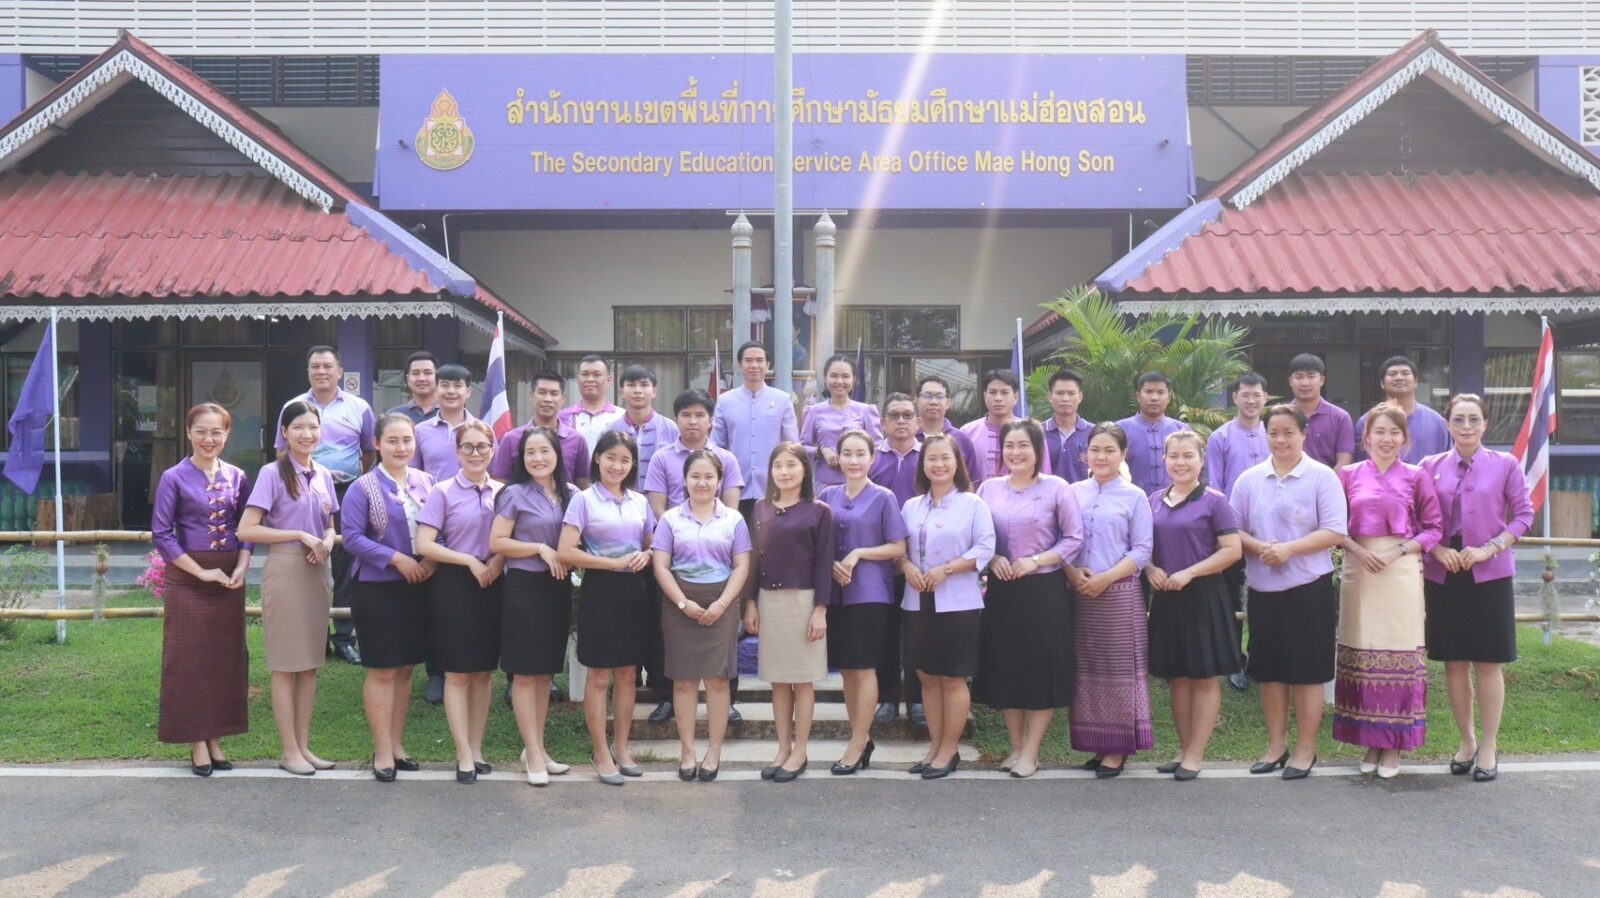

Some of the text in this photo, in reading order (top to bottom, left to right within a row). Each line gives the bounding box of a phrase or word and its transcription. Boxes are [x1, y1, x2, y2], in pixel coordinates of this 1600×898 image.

[507, 75, 1147, 126] สำนักงานเขตพื้นที่กาศึกษามัธยมศึกษาแม่ฮ่องสอน
[532, 150, 1115, 178] The Secondary Education ervice Area Office Mae Hong Son
